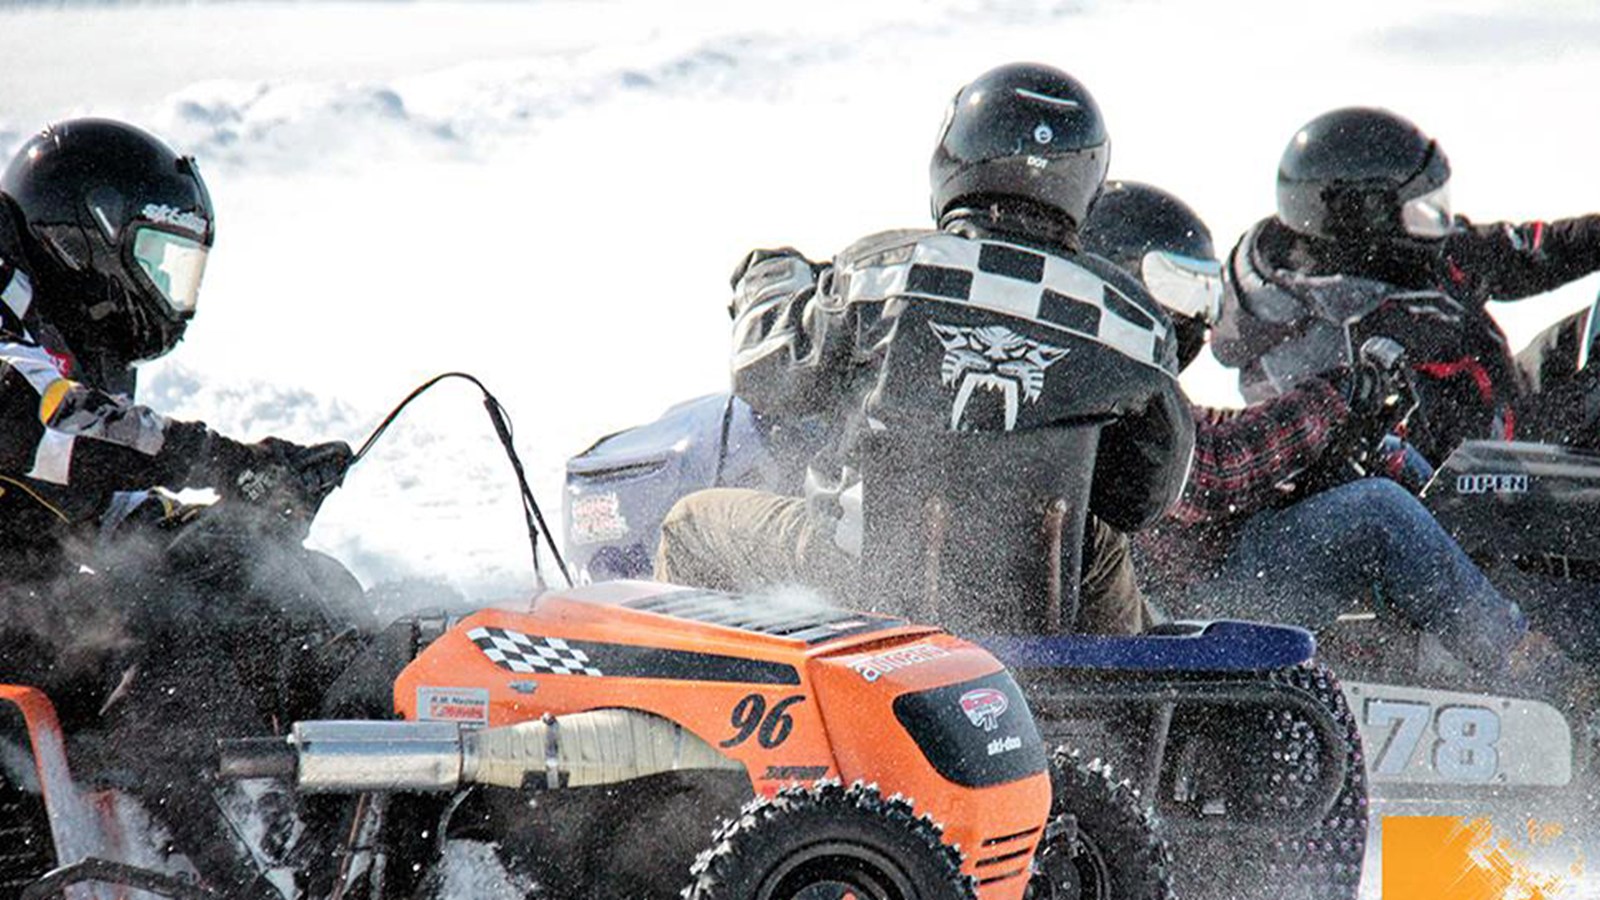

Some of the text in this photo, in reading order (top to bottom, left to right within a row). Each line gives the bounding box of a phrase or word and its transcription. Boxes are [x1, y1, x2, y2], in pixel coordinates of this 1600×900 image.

[1027, 156, 1048, 169] DOT
[1457, 474, 1528, 493] OPEN
[719, 694, 806, 749] 96
[1363, 698, 1500, 783] 78
